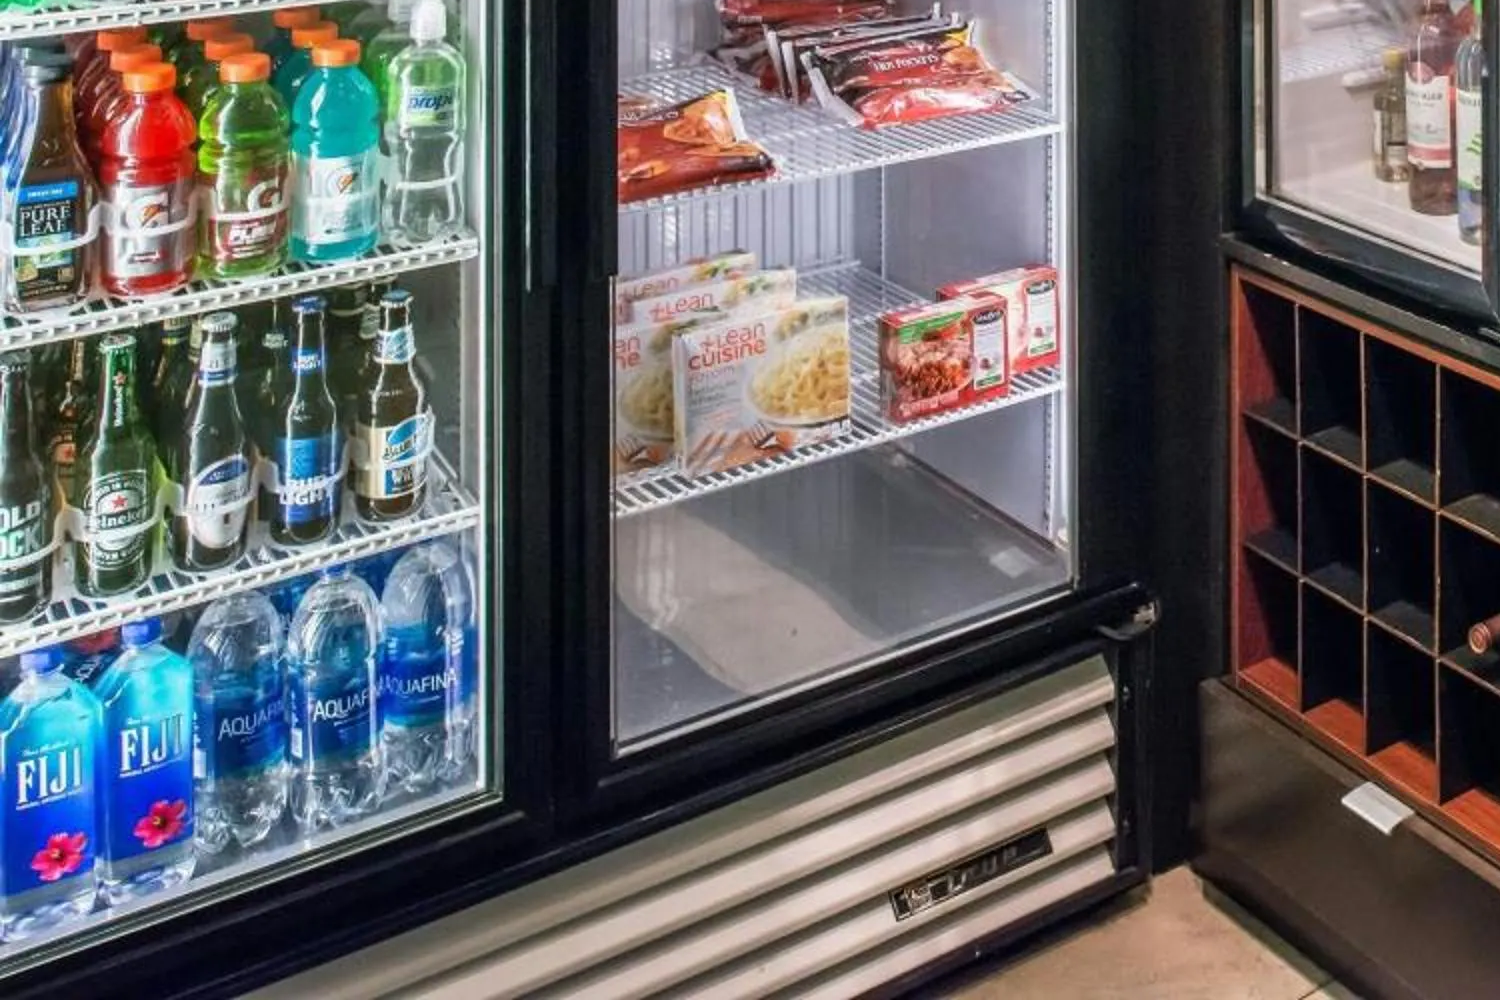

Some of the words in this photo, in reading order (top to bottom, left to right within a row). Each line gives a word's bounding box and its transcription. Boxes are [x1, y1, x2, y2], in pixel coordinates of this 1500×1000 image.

[19, 221, 66, 238] LEAF
[20, 206, 72, 222] PURE
[666, 292, 713, 317] Lean
[717, 321, 766, 348] Lean
[688, 338, 767, 371] cuisine
[0, 500, 41, 533] OLD
[0, 525, 41, 558] OCK
[119, 713, 184, 773] FIJI
[16, 747, 82, 805] FIJI
